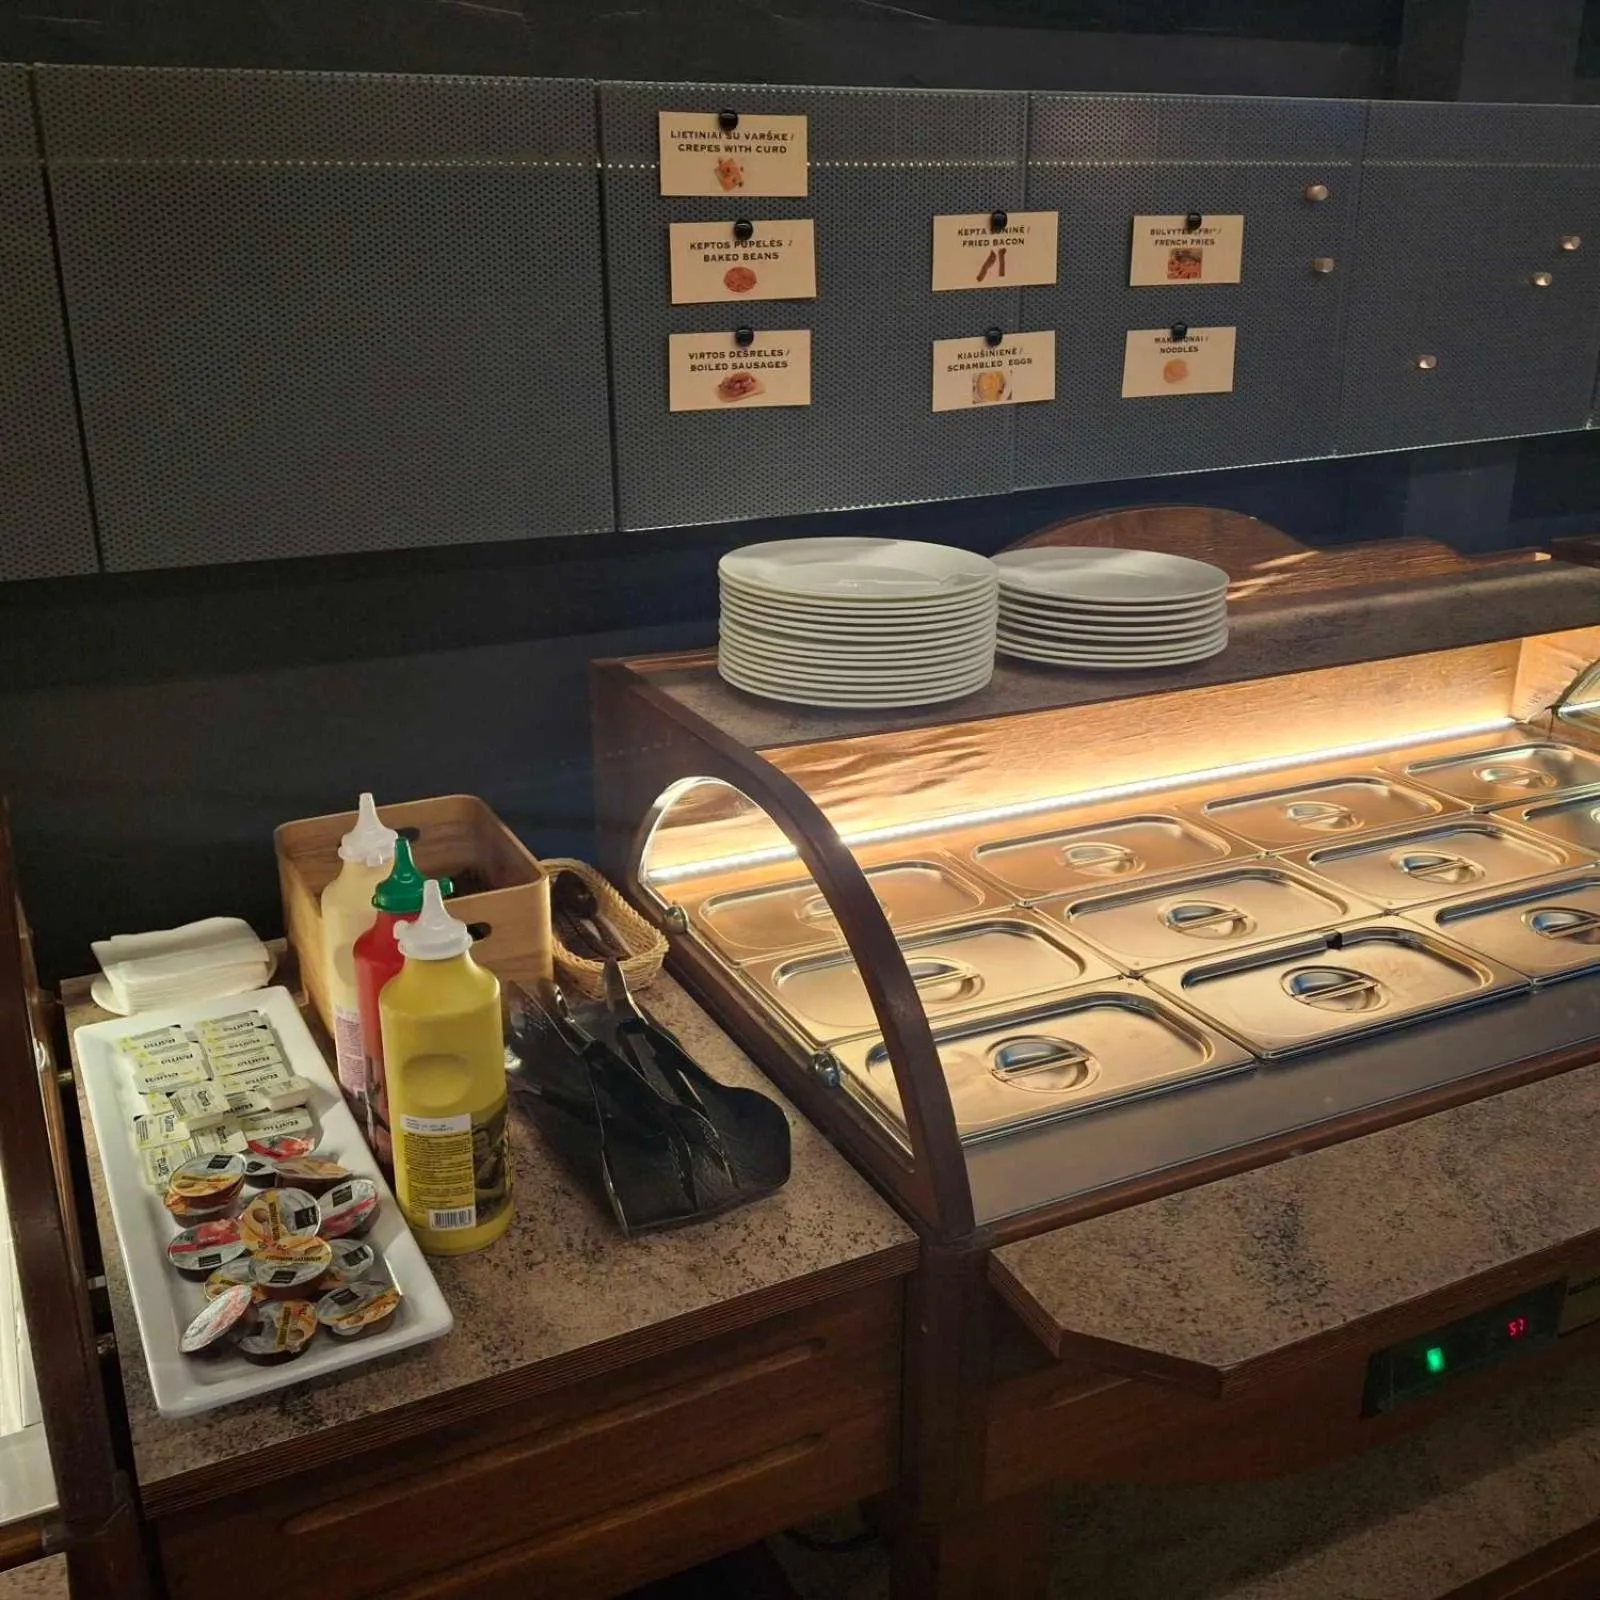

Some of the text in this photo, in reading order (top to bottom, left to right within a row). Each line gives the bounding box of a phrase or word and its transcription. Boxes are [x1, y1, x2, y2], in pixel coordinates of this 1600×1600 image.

[670, 130, 722, 140] LIETINIAI
[725, 131, 740, 140] SU
[678, 143, 787, 154] CREPES WITH CURD
[957, 227, 987, 236] KEPTA
[690, 241, 731, 250] KEPTOS
[962, 238, 1025, 248] FRIED BACON
[1190, 238, 1215, 246] FRIES
[703, 251, 779, 262] BAKED BEANS
[1160, 345, 1199, 354] NOODLES
[688, 351, 726, 360] VIRTOS
[689, 360, 788, 372] BOILED SAUSAGES
[947, 357, 1033, 373] SCRAMBLED EGGS
